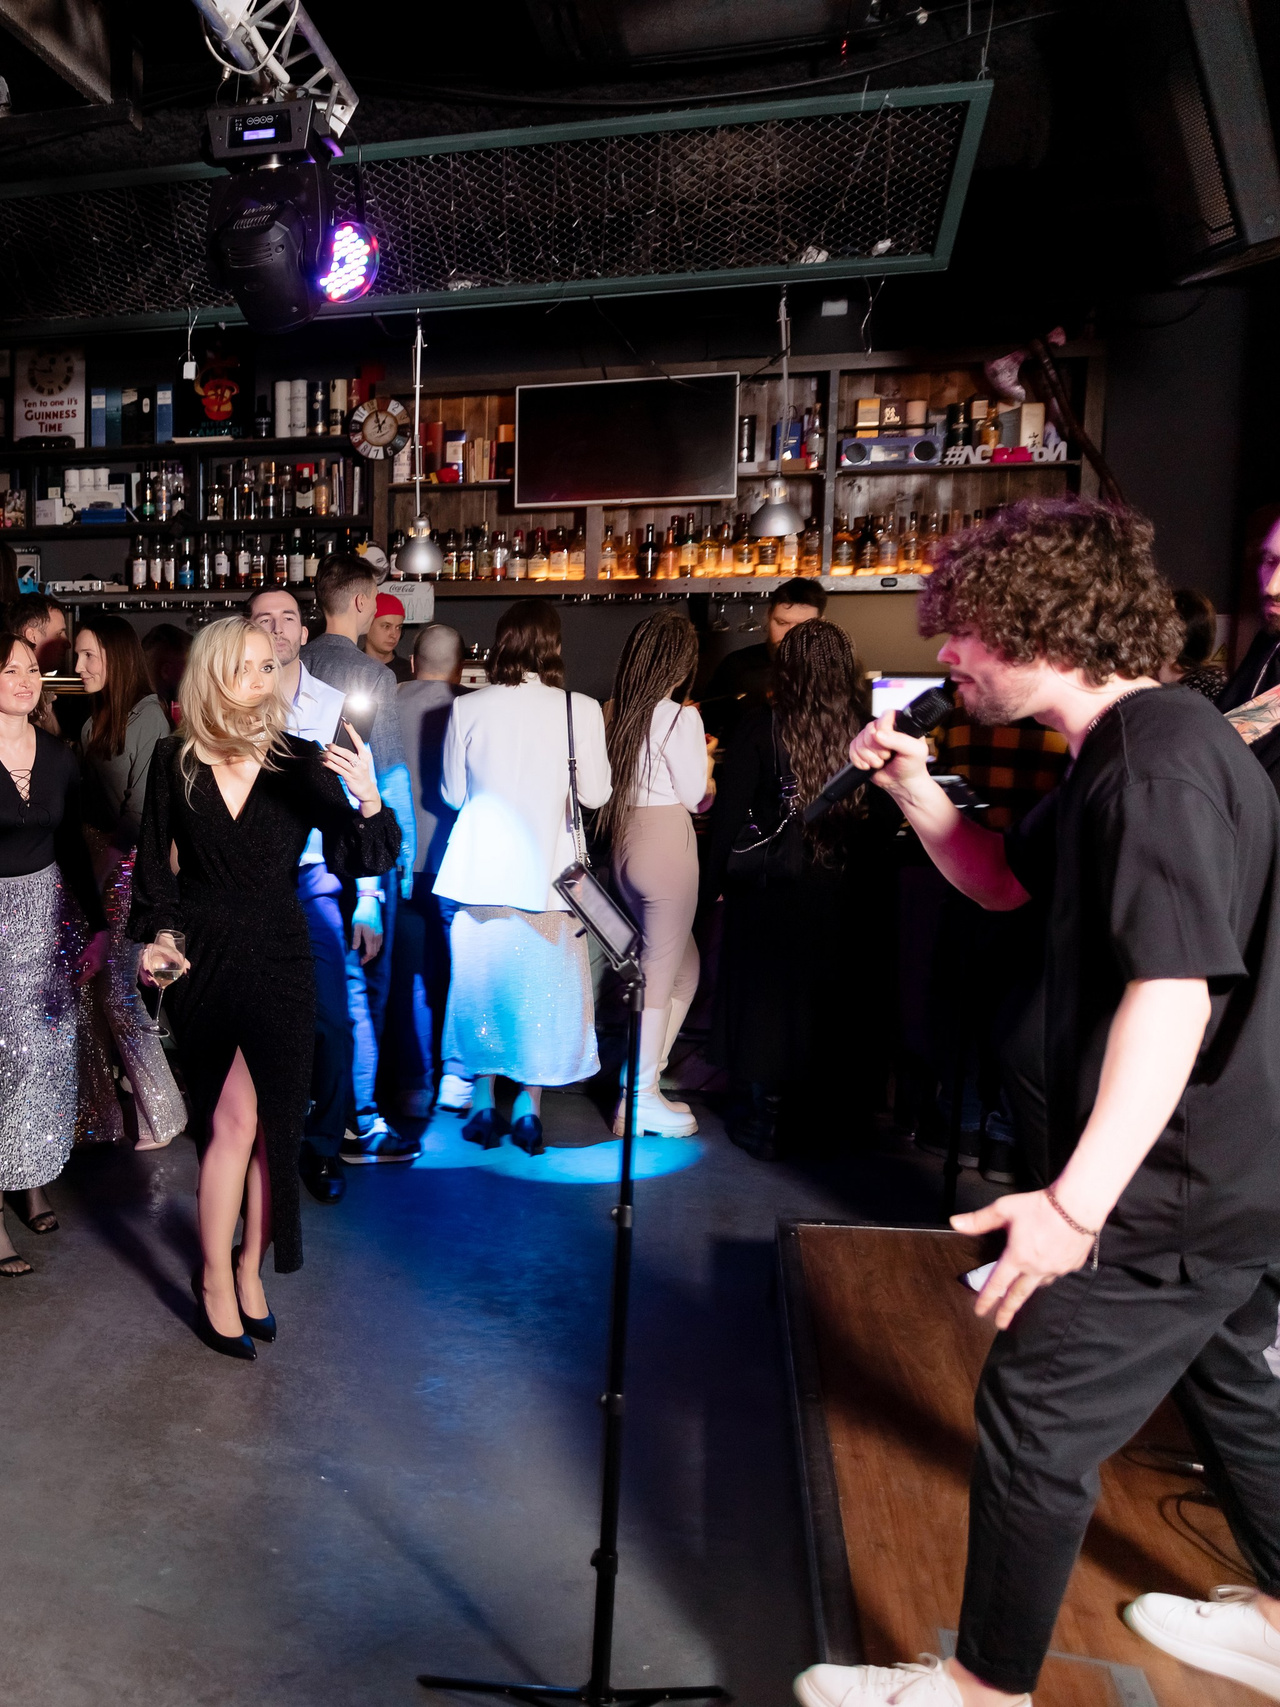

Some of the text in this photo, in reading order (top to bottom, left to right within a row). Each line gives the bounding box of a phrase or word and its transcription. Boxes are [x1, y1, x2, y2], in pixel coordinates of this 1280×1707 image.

[23, 398, 37, 408] Ten
[40, 399, 48, 407] to
[24, 409, 77, 421] GUINNESS
[38, 422, 63, 433] TIME
[386, 446, 394, 456] 6
